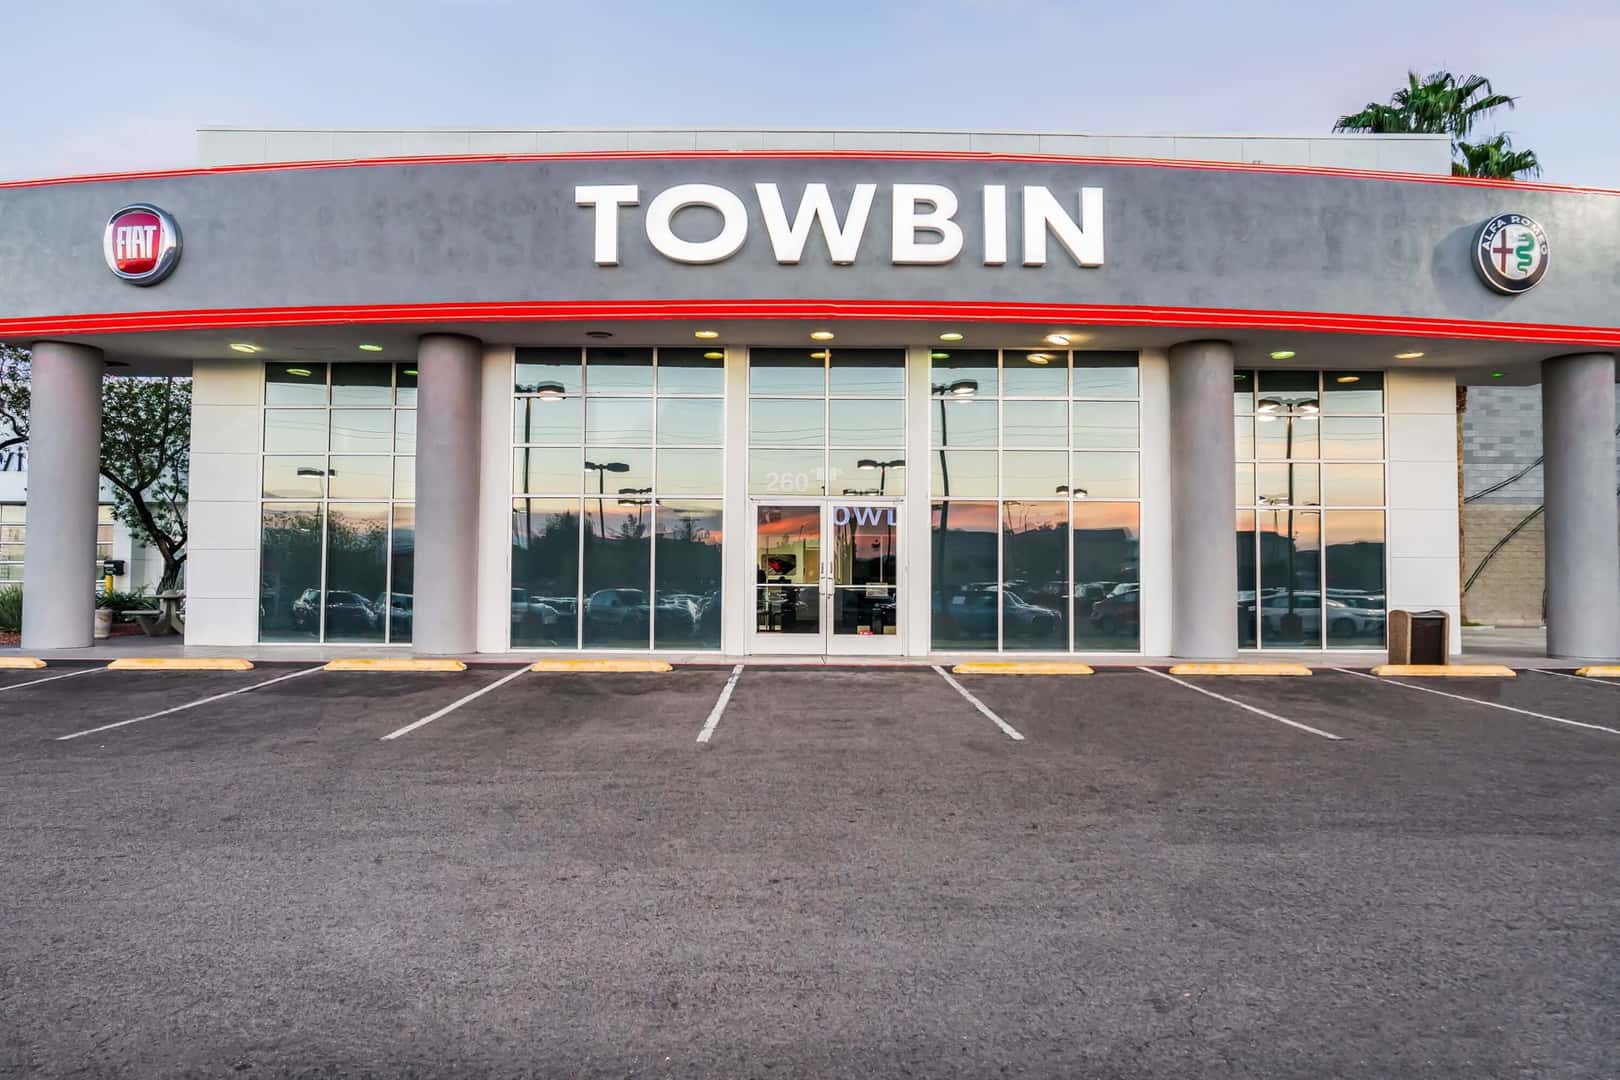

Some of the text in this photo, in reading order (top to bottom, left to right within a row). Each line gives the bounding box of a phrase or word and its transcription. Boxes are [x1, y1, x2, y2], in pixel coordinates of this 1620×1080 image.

[117, 225, 158, 260] FIAT
[575, 182, 1105, 267] TOWBIN
[1482, 215, 1548, 256] ALFA ROMEO
[766, 471, 809, 491] 260
